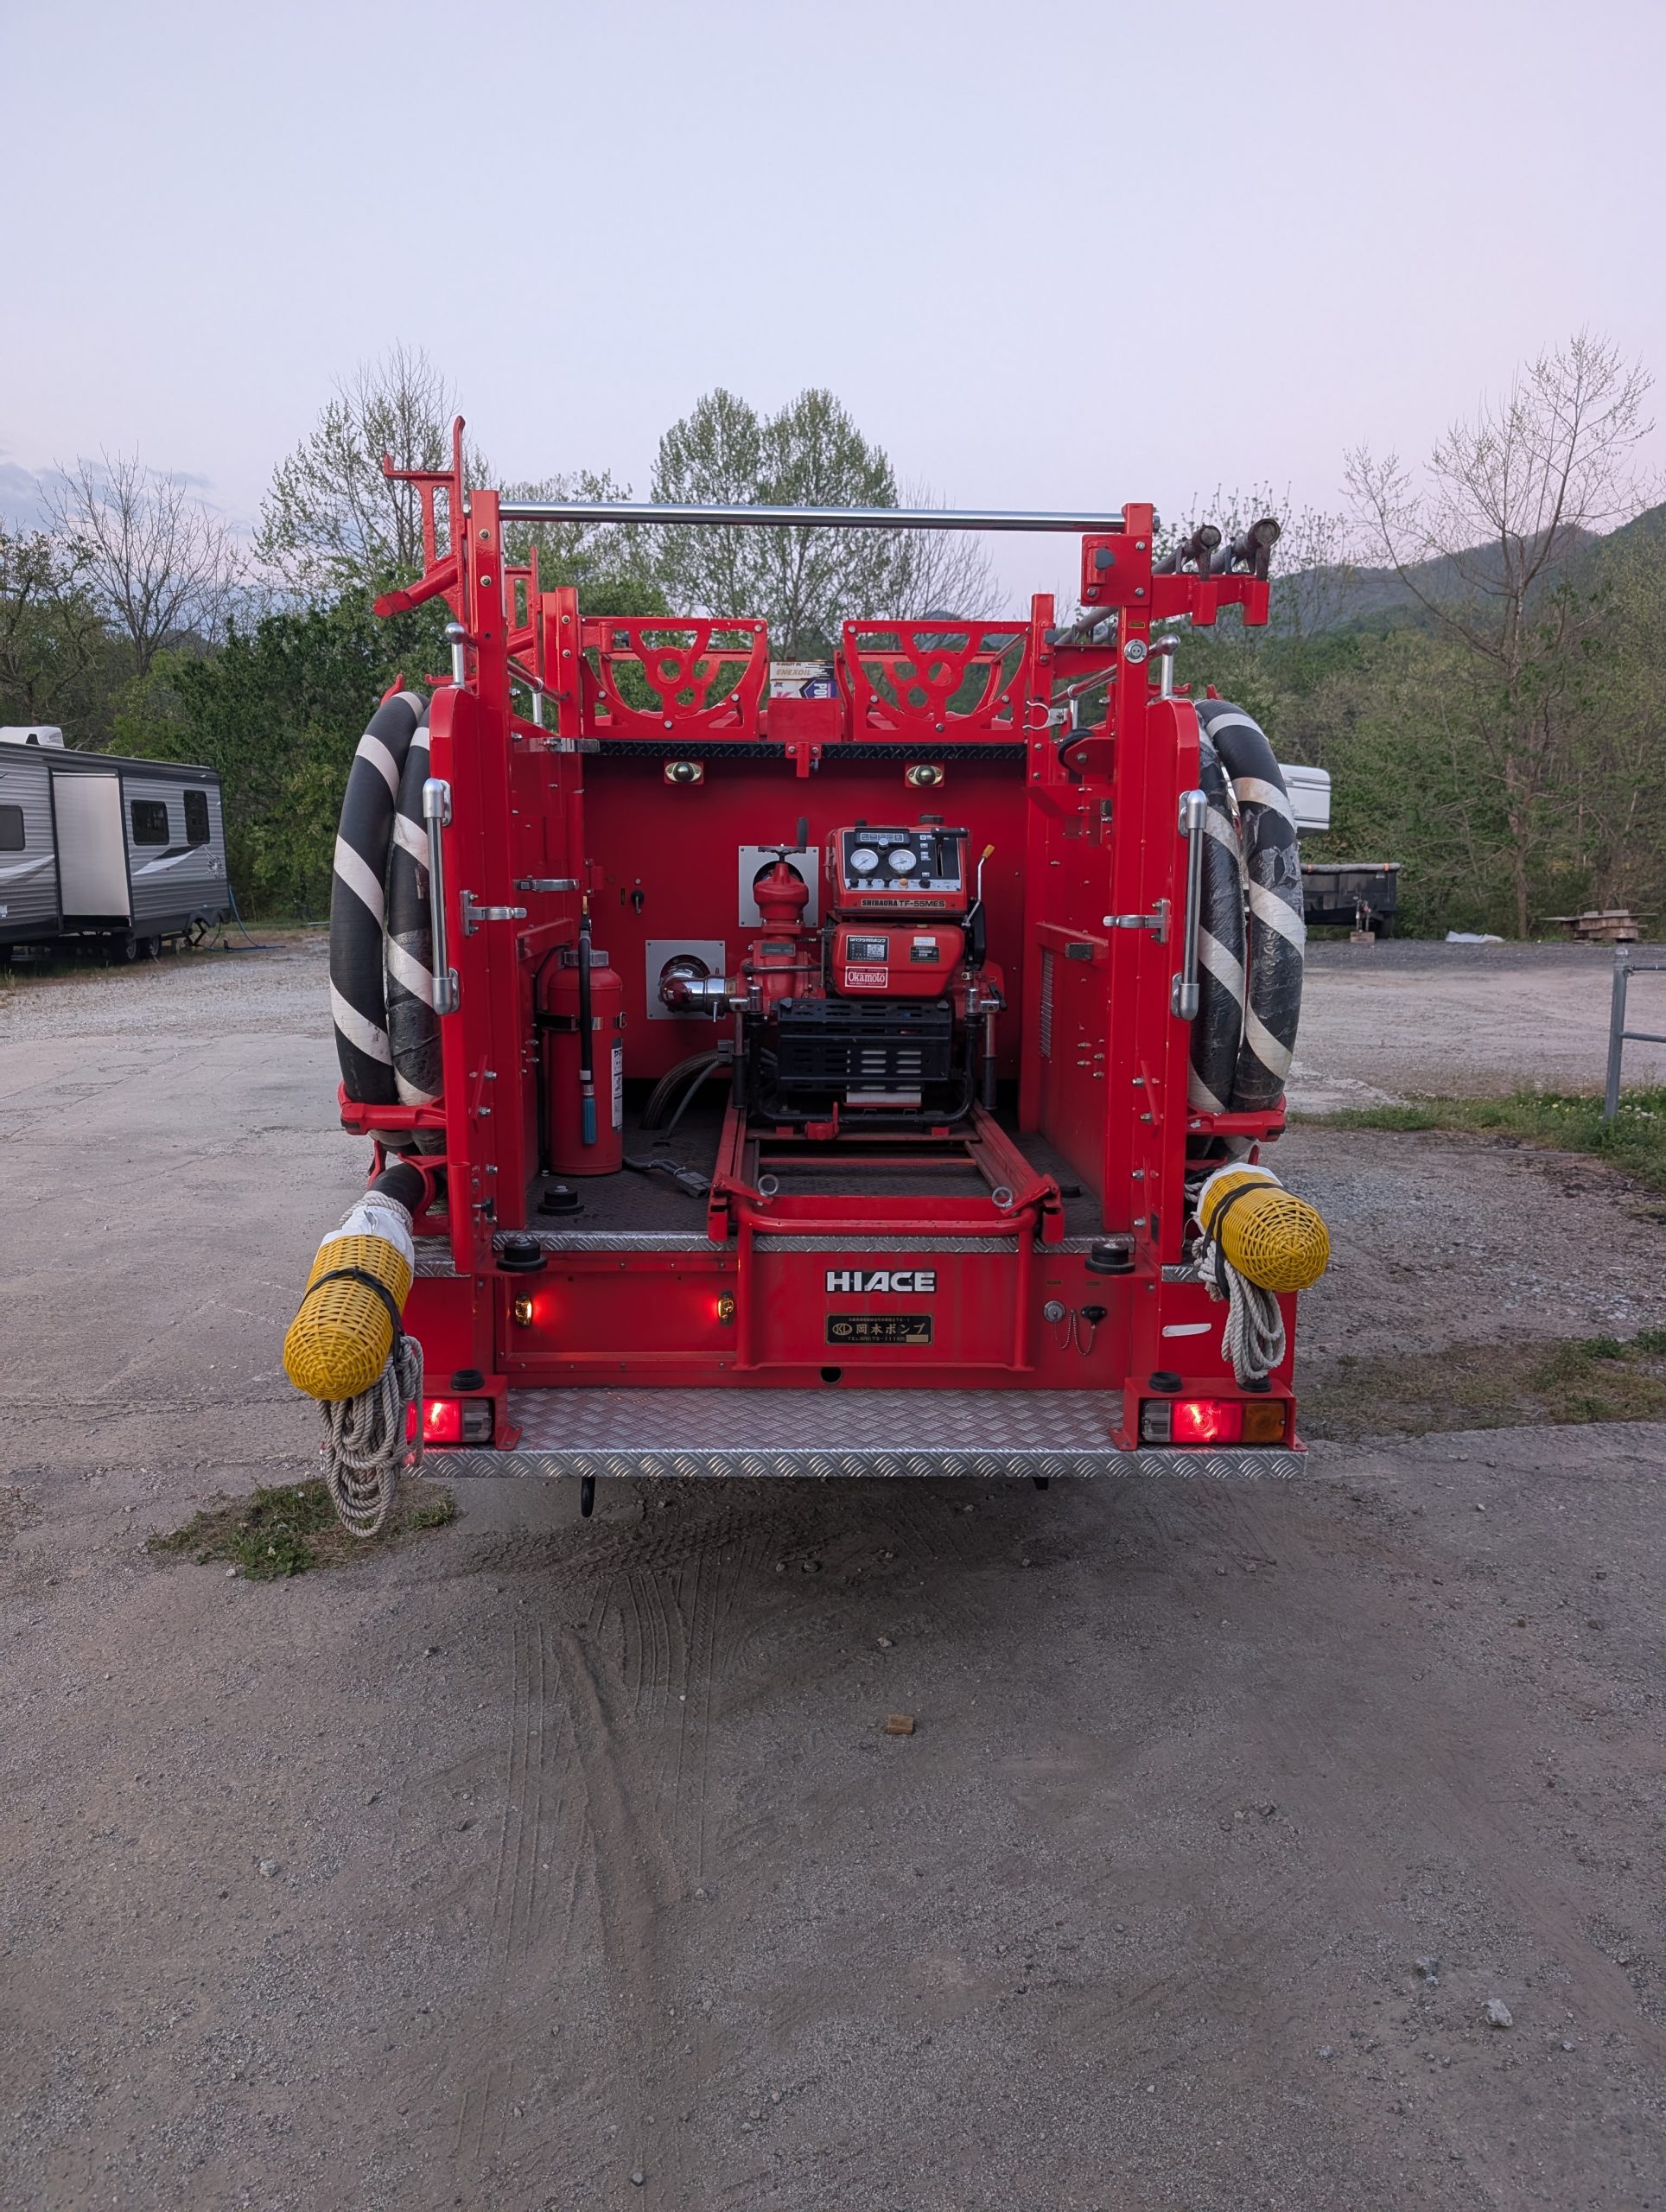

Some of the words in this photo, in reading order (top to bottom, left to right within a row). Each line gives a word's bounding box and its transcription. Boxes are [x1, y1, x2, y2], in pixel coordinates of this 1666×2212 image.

[848, 971, 886, 982] Okamoto
[826, 1271, 935, 1292] HIACE
[856, 1324, 925, 1335] 岡本ポンプ
